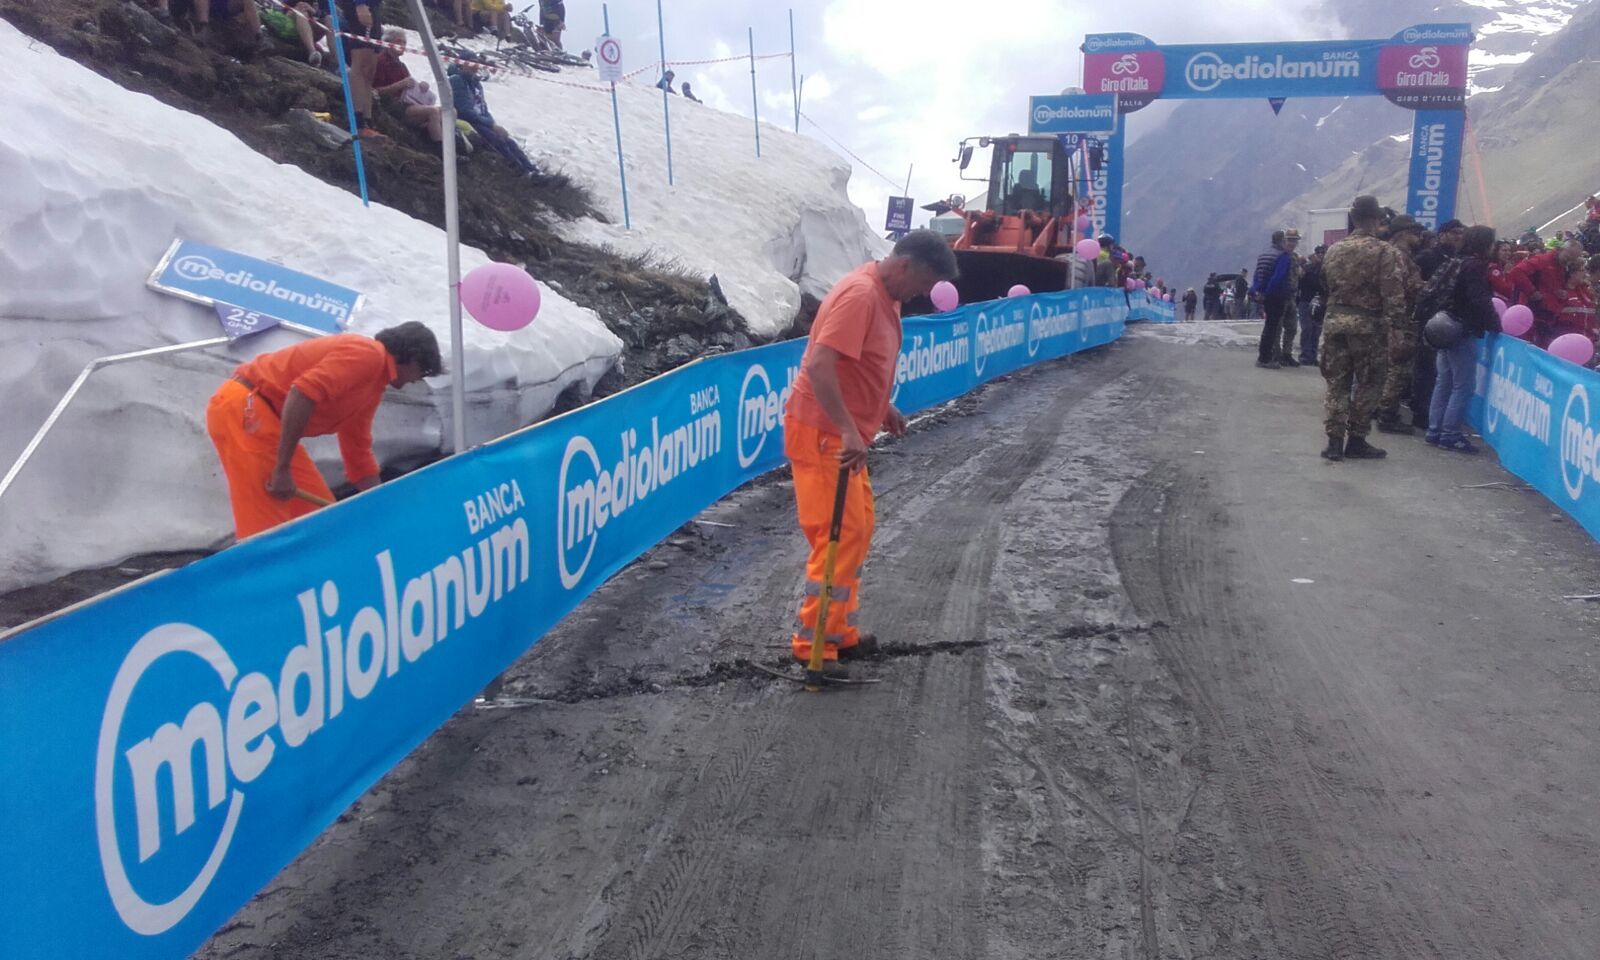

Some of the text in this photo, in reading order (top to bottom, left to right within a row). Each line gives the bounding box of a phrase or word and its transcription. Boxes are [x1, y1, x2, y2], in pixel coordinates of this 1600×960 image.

[1087, 37, 1146, 48] mediolanum
[1404, 28, 1468, 41] mediolanum
[1323, 51, 1360, 60] BANCA
[1187, 53, 1360, 86] mediolanum
[1397, 71, 1449, 86] Giro d'Italia
[1101, 76, 1149, 91] Giro d'Italia
[1035, 106, 1112, 121] mediolanum
[1065, 134, 1078, 144] 10
[1418, 124, 1429, 156] BANCA
[1415, 123, 1446, 232] diolanum
[177, 257, 348, 318] mediolanum
[314, 293, 349, 309] BANCA
[226, 308, 259, 326] 25
[228, 320, 252, 331] GPM
[894, 332, 969, 385] ediolanum
[690, 384, 721, 415] BANCA
[560, 410, 721, 573] mediolanum
[463, 479, 525, 534] BANCA
[105, 518, 529, 905] mediolanum
